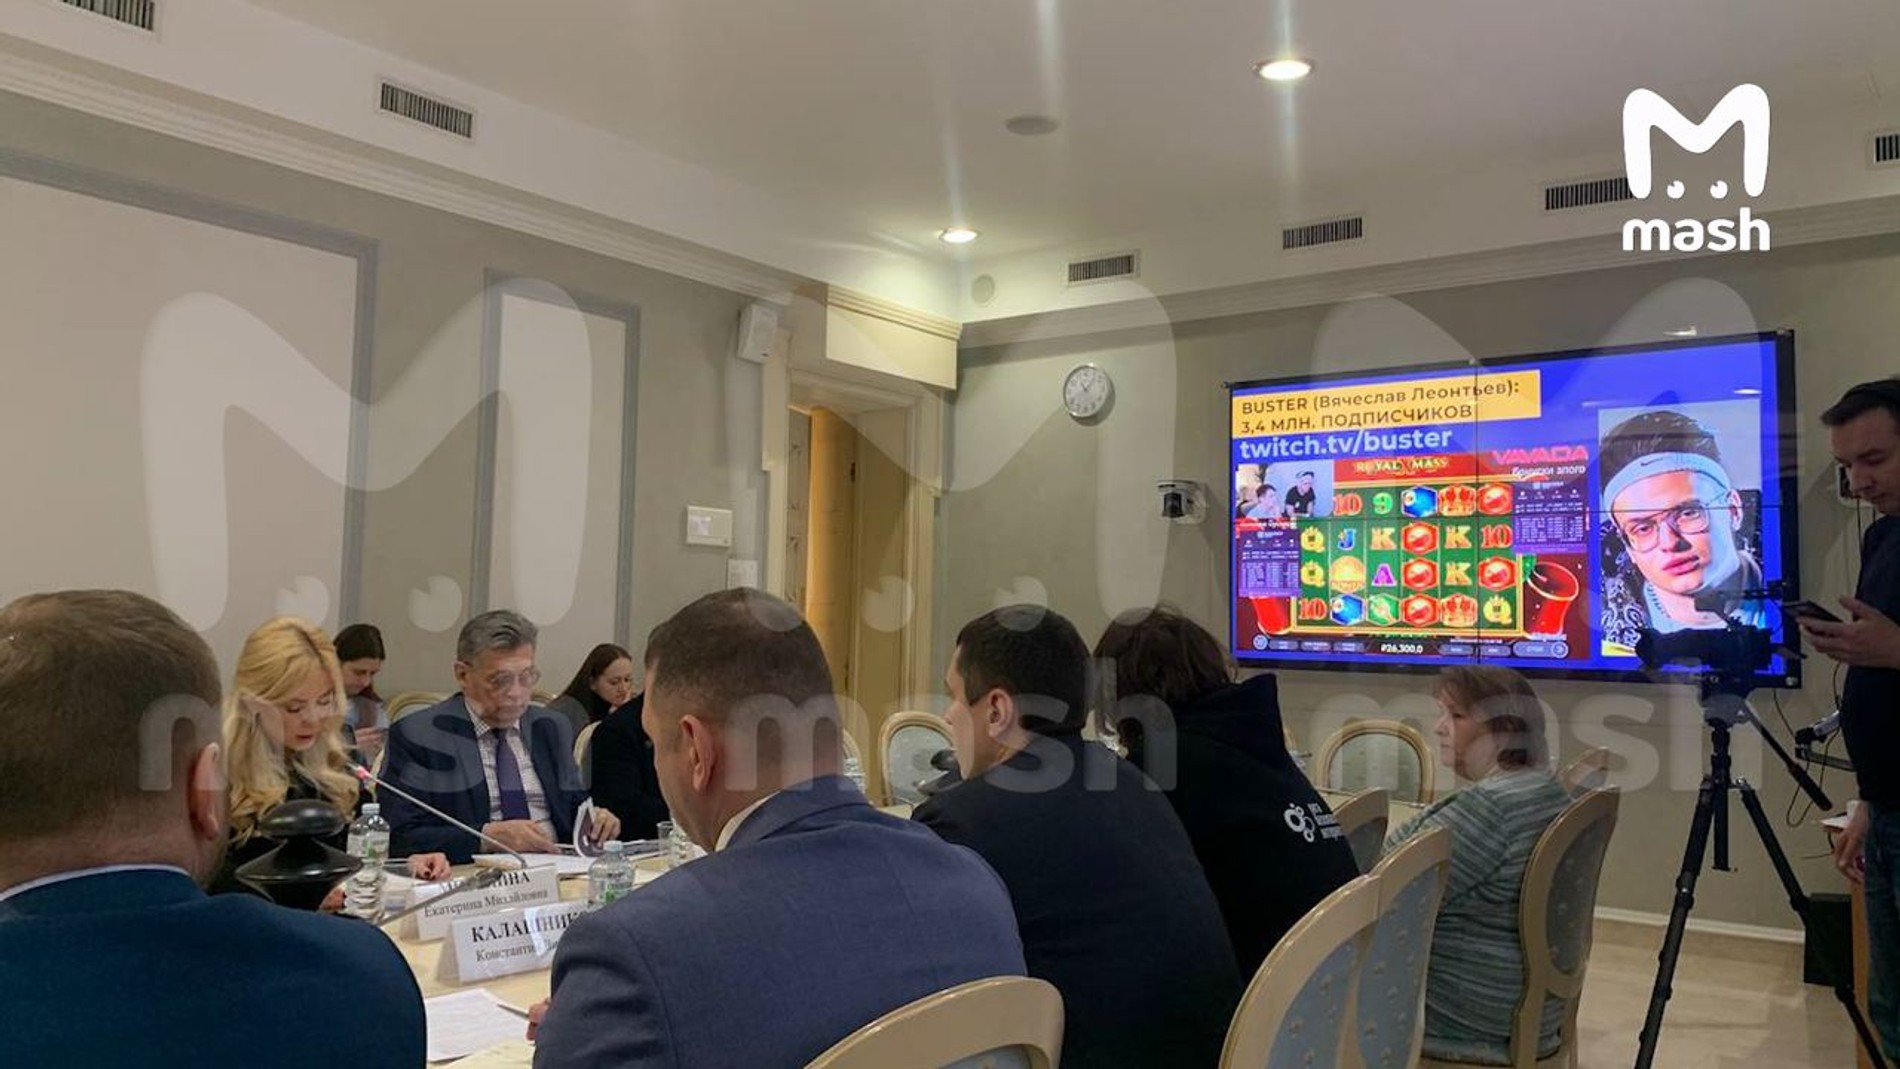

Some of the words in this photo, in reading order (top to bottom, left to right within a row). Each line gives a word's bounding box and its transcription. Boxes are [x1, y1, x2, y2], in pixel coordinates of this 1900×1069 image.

[1242, 398, 1307, 415] BUSTER
[1313, 390, 1405, 412] (Вячеслав
[1411, 382, 1519, 403] Леонтьев):
[1241, 419, 1266, 435] 3,4
[1270, 415, 1317, 432] МЛН.
[1321, 405, 1473, 428] ПОДПИСЧИКОВ
[1239, 428, 1453, 460] twitch.tv/buster
[1332, 493, 1362, 516] 10
[1373, 492, 1393, 515] 9
[1370, 527, 1397, 550] K
[1444, 525, 1472, 549] K
[1481, 523, 1513, 549] 10
[1371, 563, 1397, 587] A
[1444, 562, 1472, 585] K
[1298, 598, 1327, 620] 10
[424, 900, 483, 917] Екатерина
[476, 945, 537, 963] Константи
